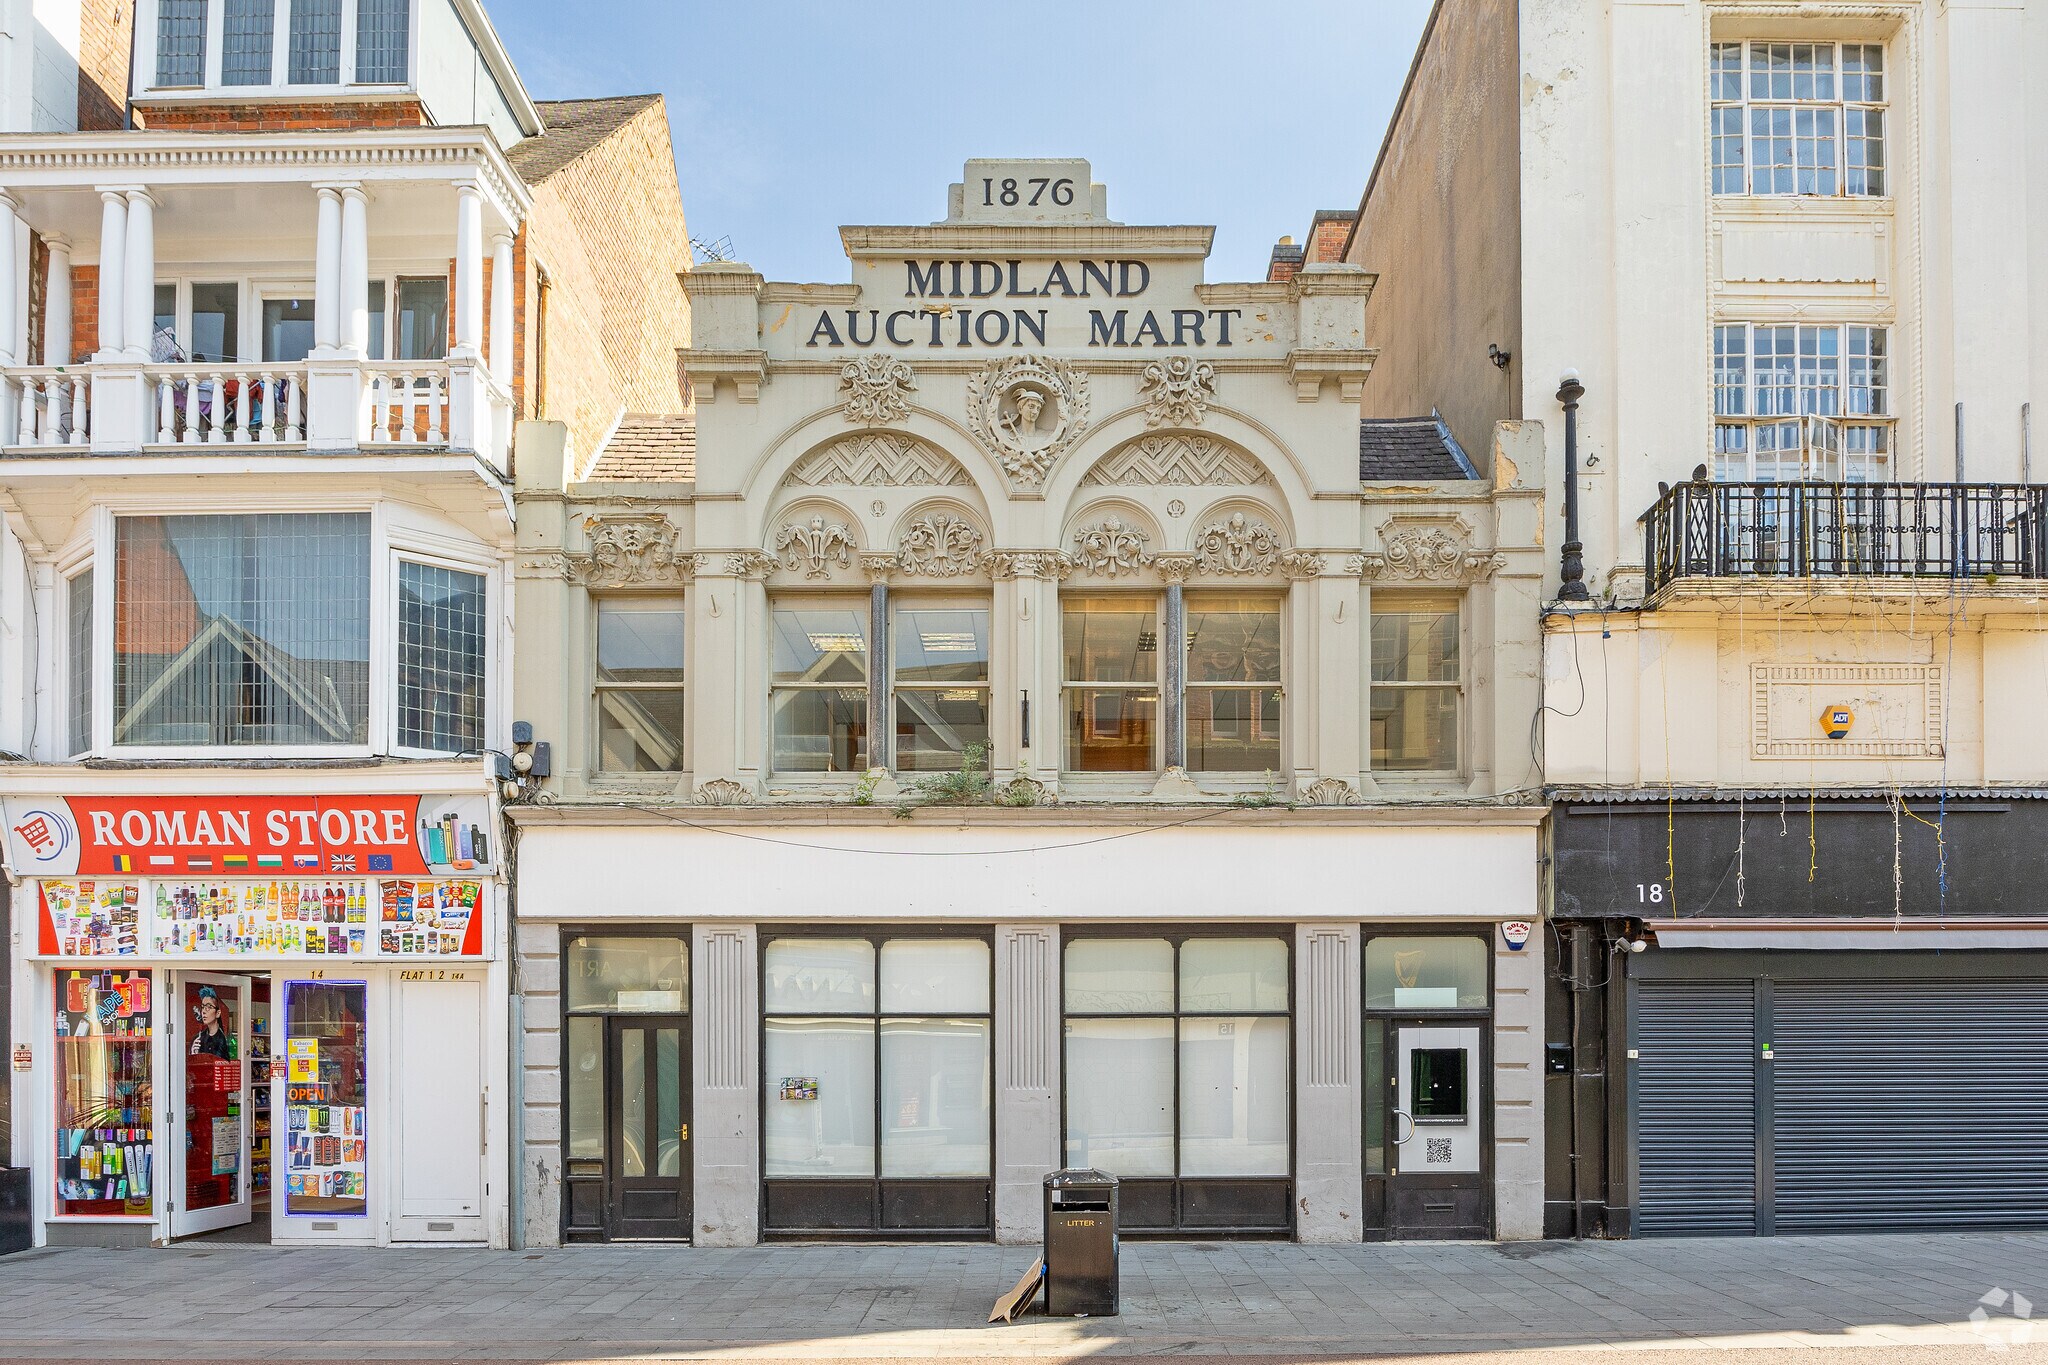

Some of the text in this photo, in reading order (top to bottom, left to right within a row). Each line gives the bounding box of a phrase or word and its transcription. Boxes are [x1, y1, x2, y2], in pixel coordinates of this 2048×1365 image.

[982, 178, 1075, 207] 1876
[904, 260, 1150, 298] MIDLAND
[806, 309, 1242, 348] AUCTION MART
[1833, 713, 1849, 723] ADT
[89, 809, 251, 847] ROMAN
[266, 808, 409, 847] STORE
[1636, 883, 1663, 903] 18
[1506, 922, 1529, 932] SOLAR
[311, 969, 324, 980] 14
[400, 970, 465, 980] FLAT 1 2 14A
[288, 1088, 325, 1101] OPEN
[1067, 1219, 1095, 1227] LITTER
